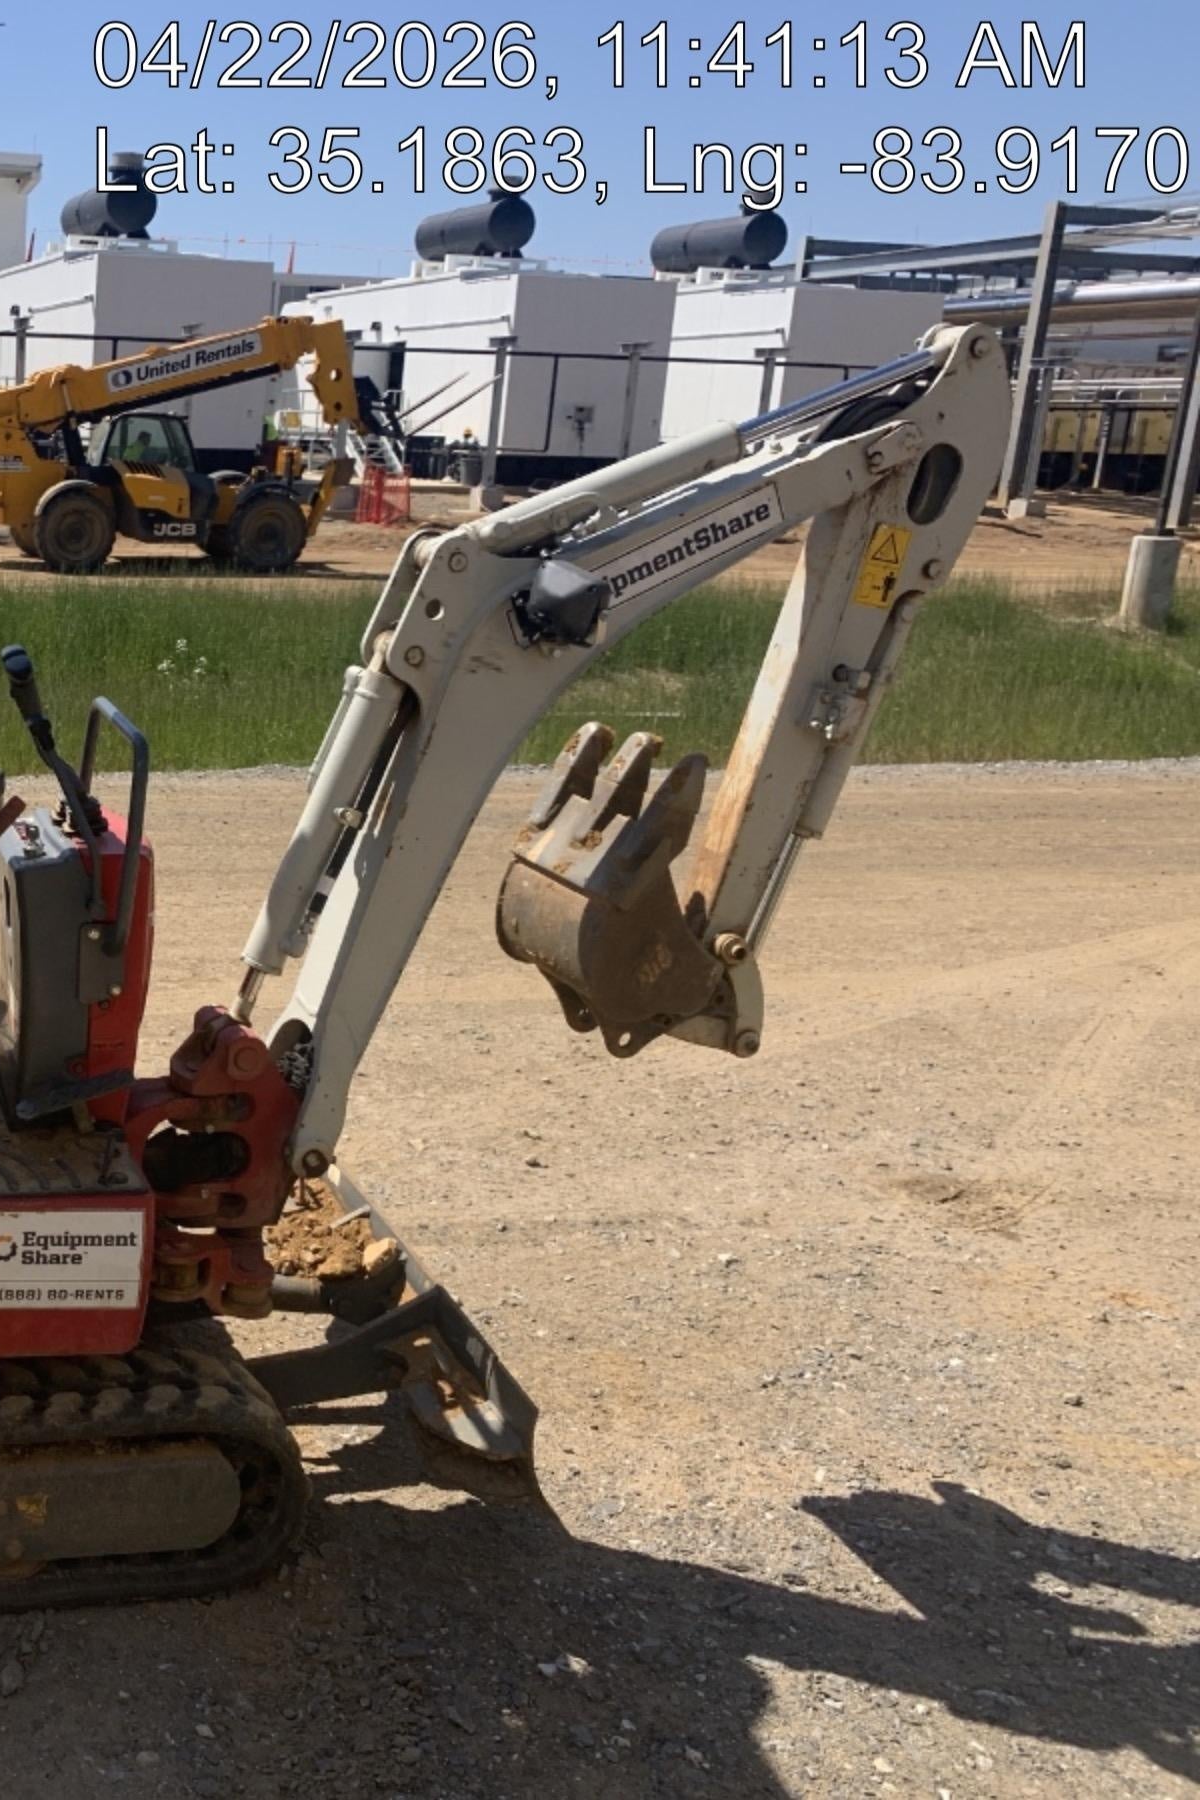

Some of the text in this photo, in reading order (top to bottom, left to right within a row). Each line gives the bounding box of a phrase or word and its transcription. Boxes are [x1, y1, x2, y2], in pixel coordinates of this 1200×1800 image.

[136, 339, 255, 381] United Rentals
[153, 523, 197, 537] JCB
[602, 500, 771, 599] pmentShare
[21, 1231, 138, 1251] Equipment
[21, 1250, 84, 1266] Share
